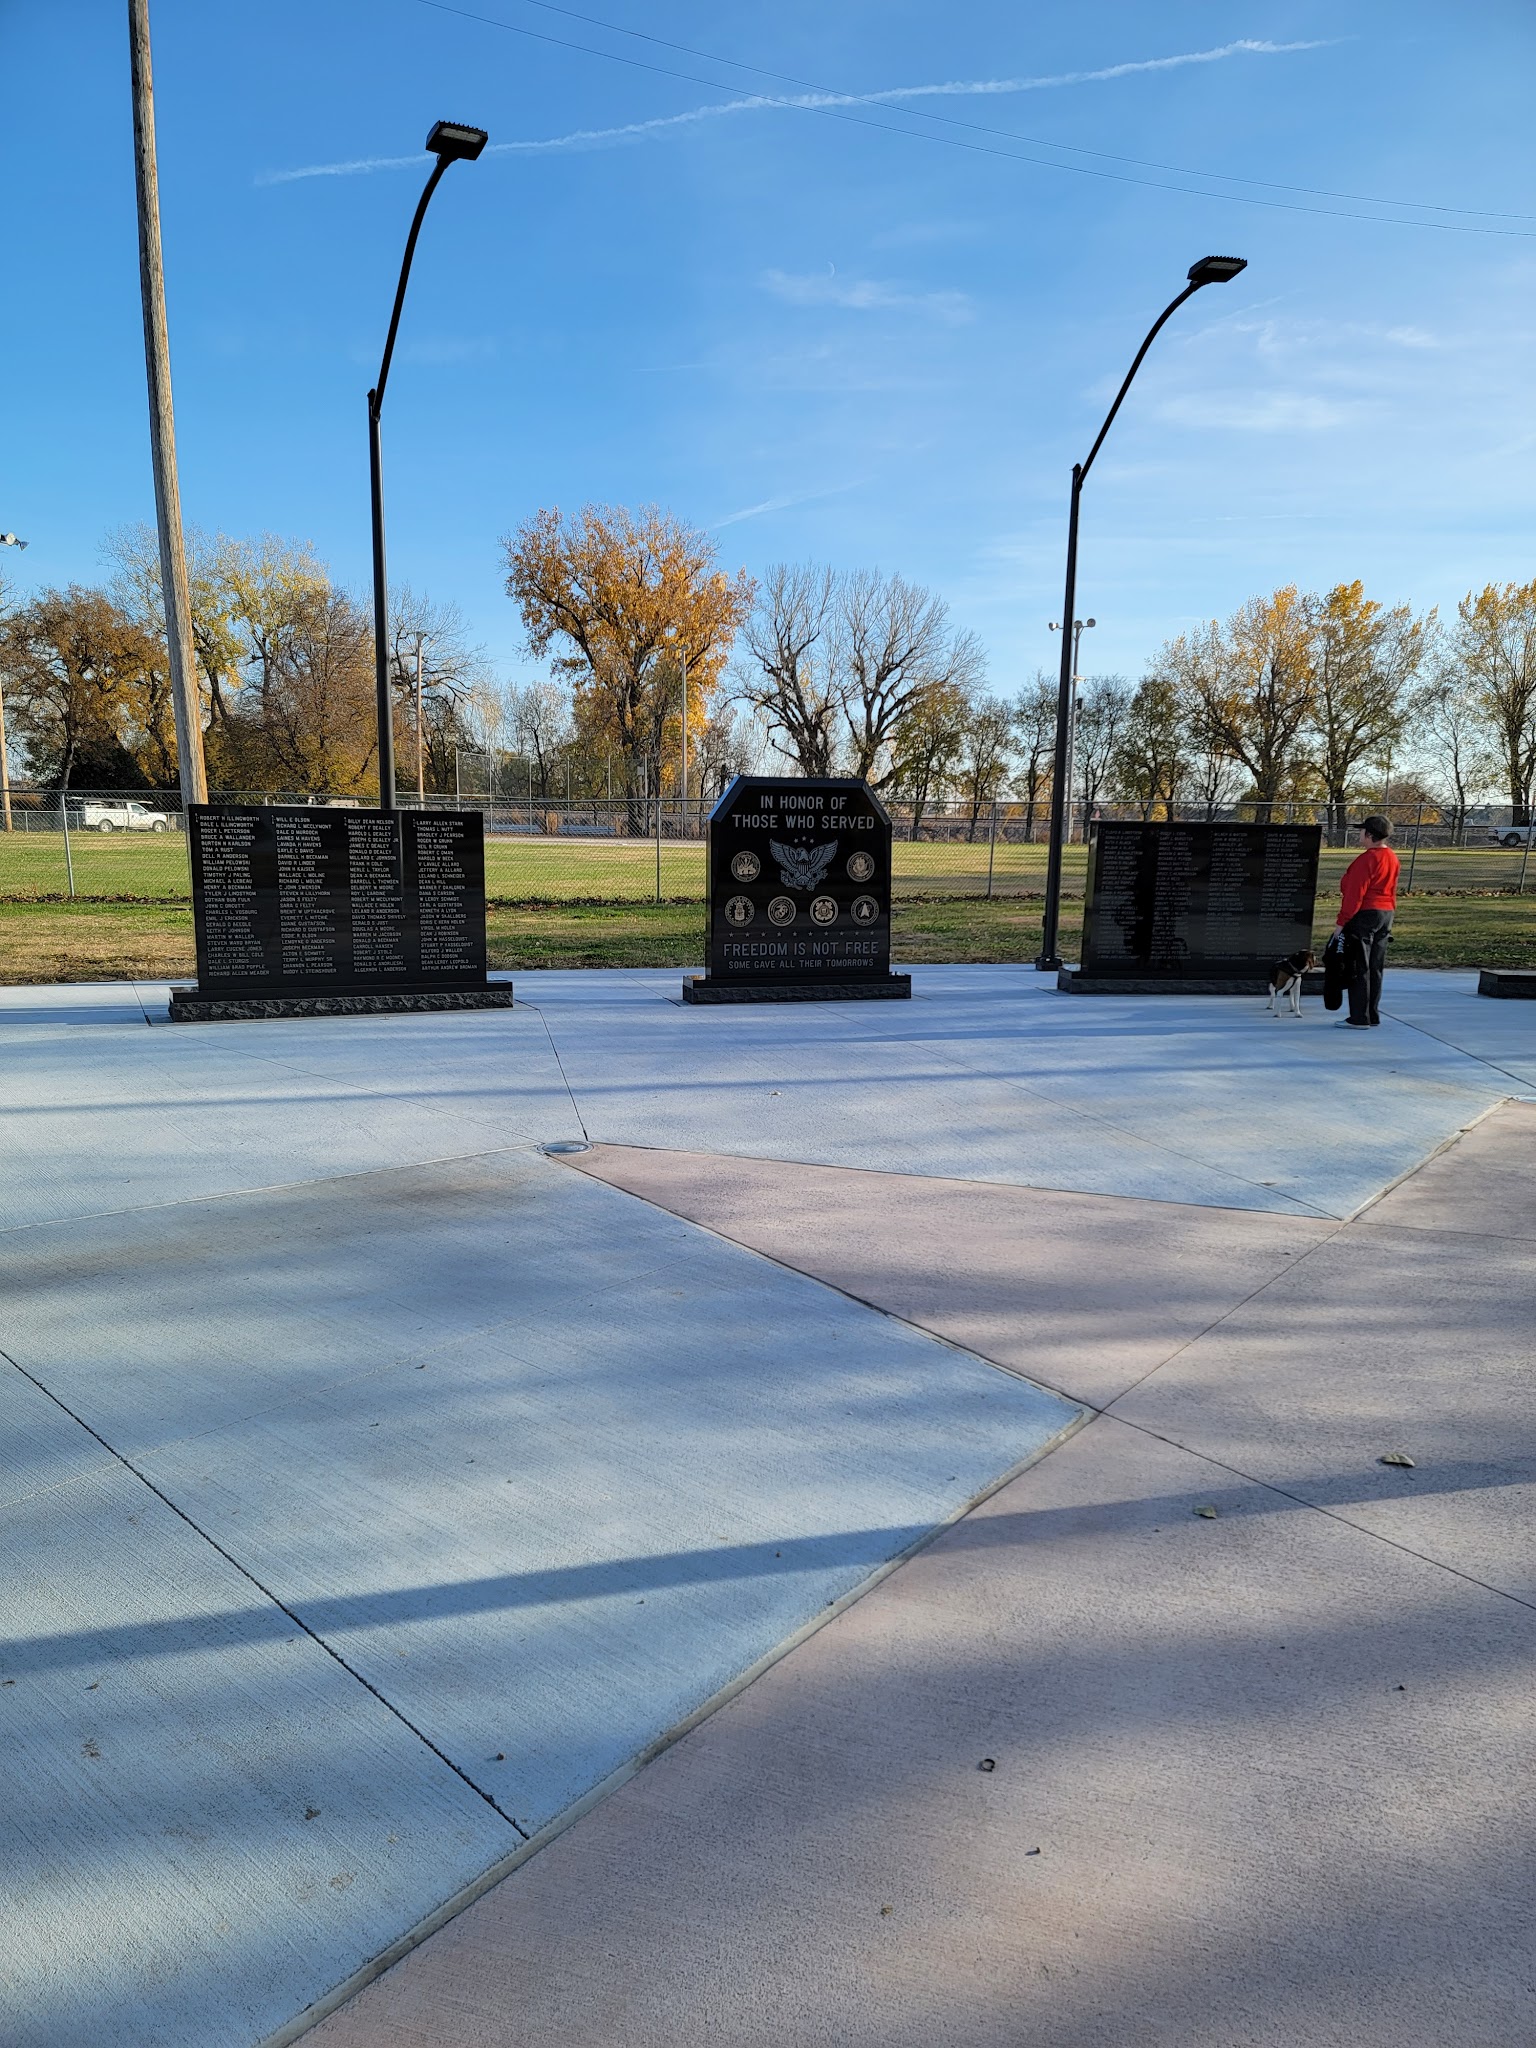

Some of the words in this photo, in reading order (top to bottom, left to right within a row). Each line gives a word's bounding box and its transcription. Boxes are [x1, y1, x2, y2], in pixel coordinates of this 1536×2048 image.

[761, 795, 773, 809] IN
[780, 796, 823, 809] HONOR
[831, 797, 847, 810] OF
[732, 815, 778, 828] THOSE
[786, 816, 814, 828] WHO
[822, 816, 874, 829] SERVED
[724, 943, 787, 956] FREEDOM
[794, 943, 805, 955] IS
[813, 942, 838, 955] NOT
[846, 942, 878, 954] FREE
[729, 961, 750, 969] SOME
[754, 960, 775, 968] GAVE
[780, 960, 795, 968] ALL
[800, 959, 821, 967] THEIR
[826, 959, 873, 967] TOMORROWS
